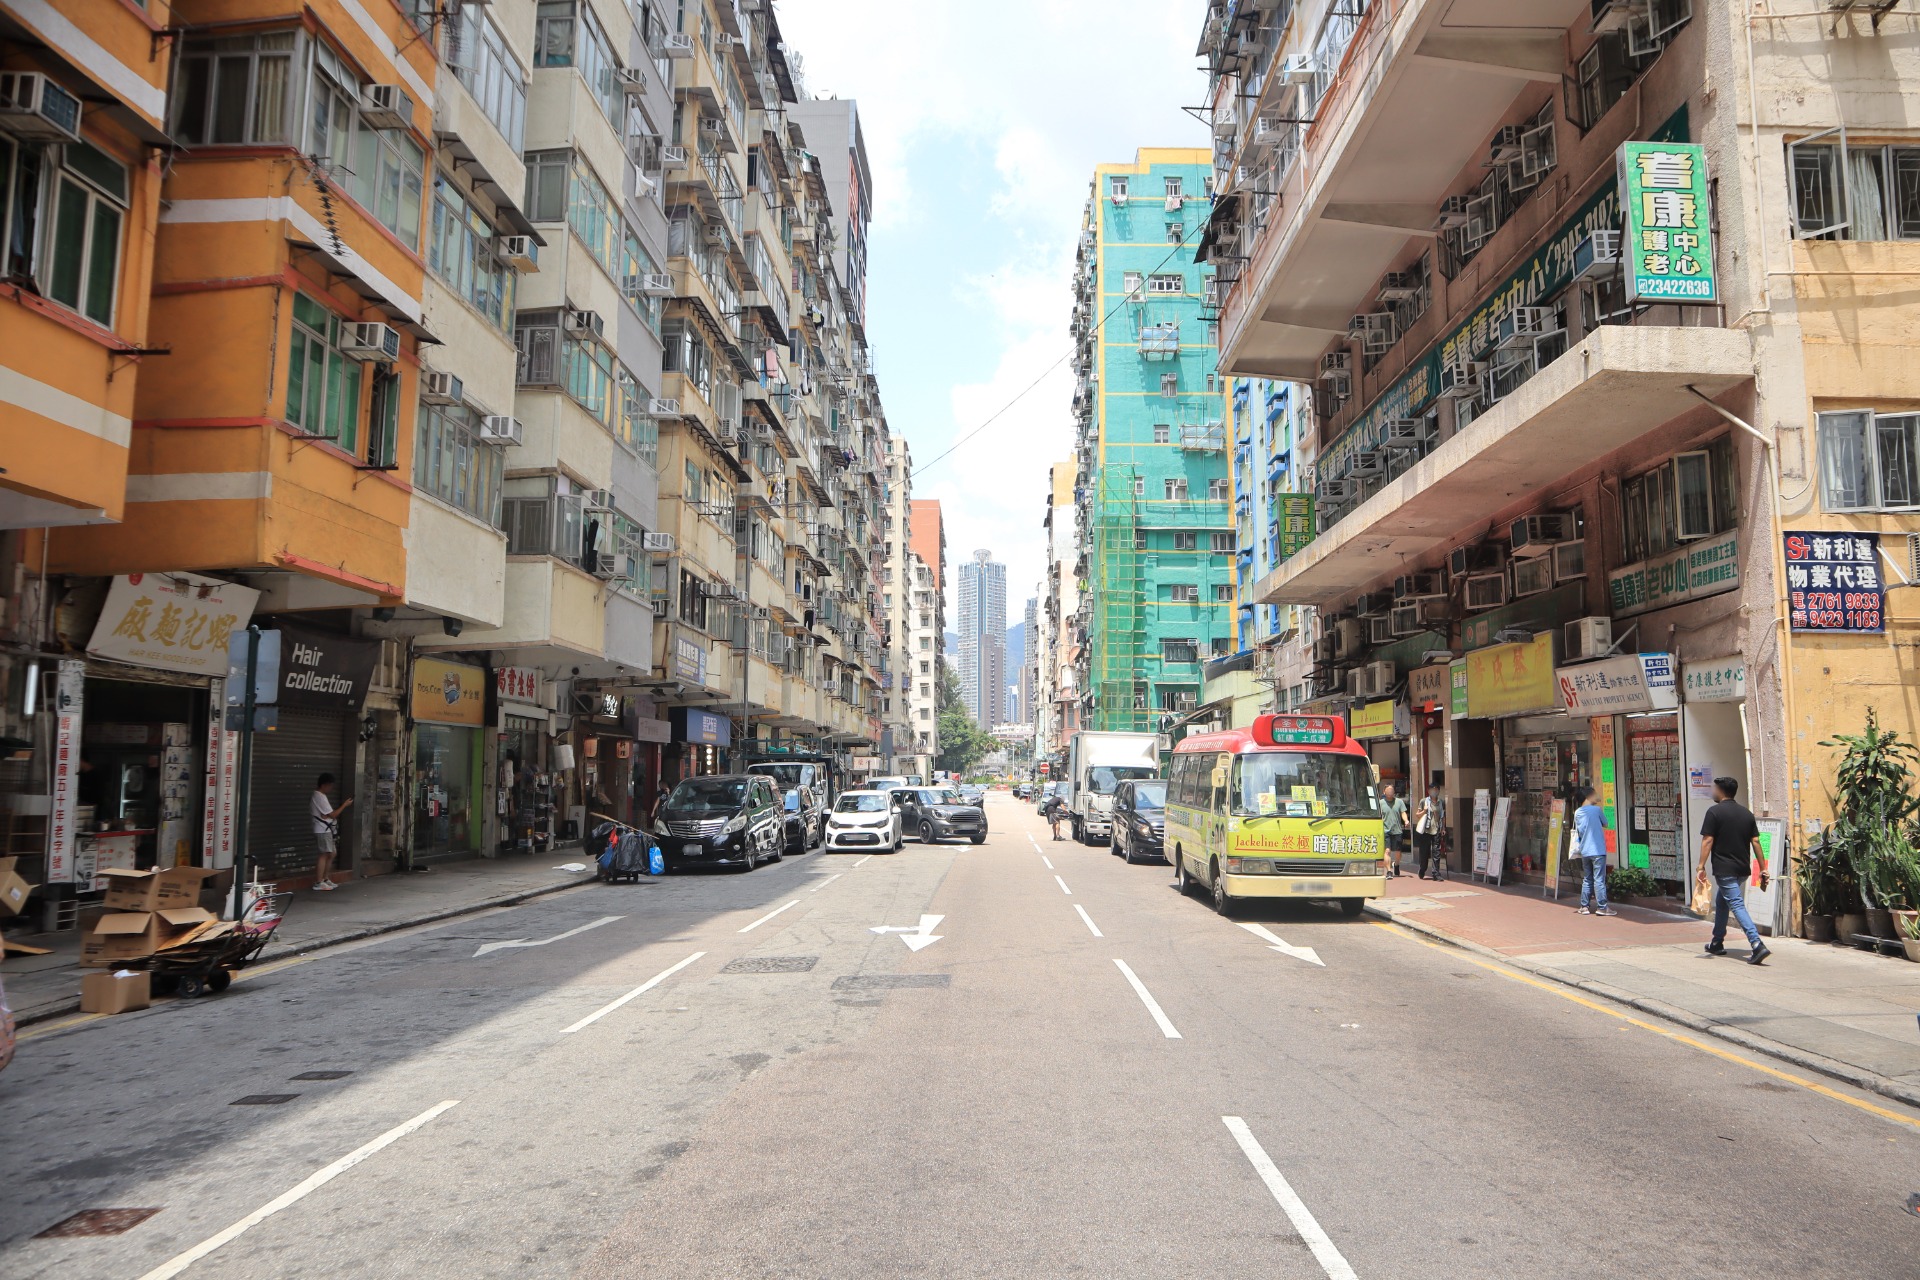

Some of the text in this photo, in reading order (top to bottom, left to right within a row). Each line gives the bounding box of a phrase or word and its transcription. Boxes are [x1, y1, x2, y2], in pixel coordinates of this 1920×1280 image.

[1648, 278, 1710, 296] 23422636
[1813, 538, 1873, 560] 新利達
[1611, 558, 1688, 610] 耆康護老中心
[1788, 565, 1878, 588] 物業代理
[1808, 592, 1842, 609] 2761
[1845, 592, 1880, 610] 9833
[1810, 611, 1844, 627] 9423
[1847, 611, 1880, 627] 1183
[292, 643, 324, 666] Hair
[285, 671, 353, 695] collection
[1574, 671, 1610, 692] 新利達
[1610, 674, 1639, 689] 物業代理
[1686, 667, 1743, 689] 耆康護老中心
[1603, 695, 1626, 704] PROPERTY
[1627, 692, 1645, 702] AGENCY
[1235, 834, 1379, 854] Jackeline 終極 暗瘡療法
